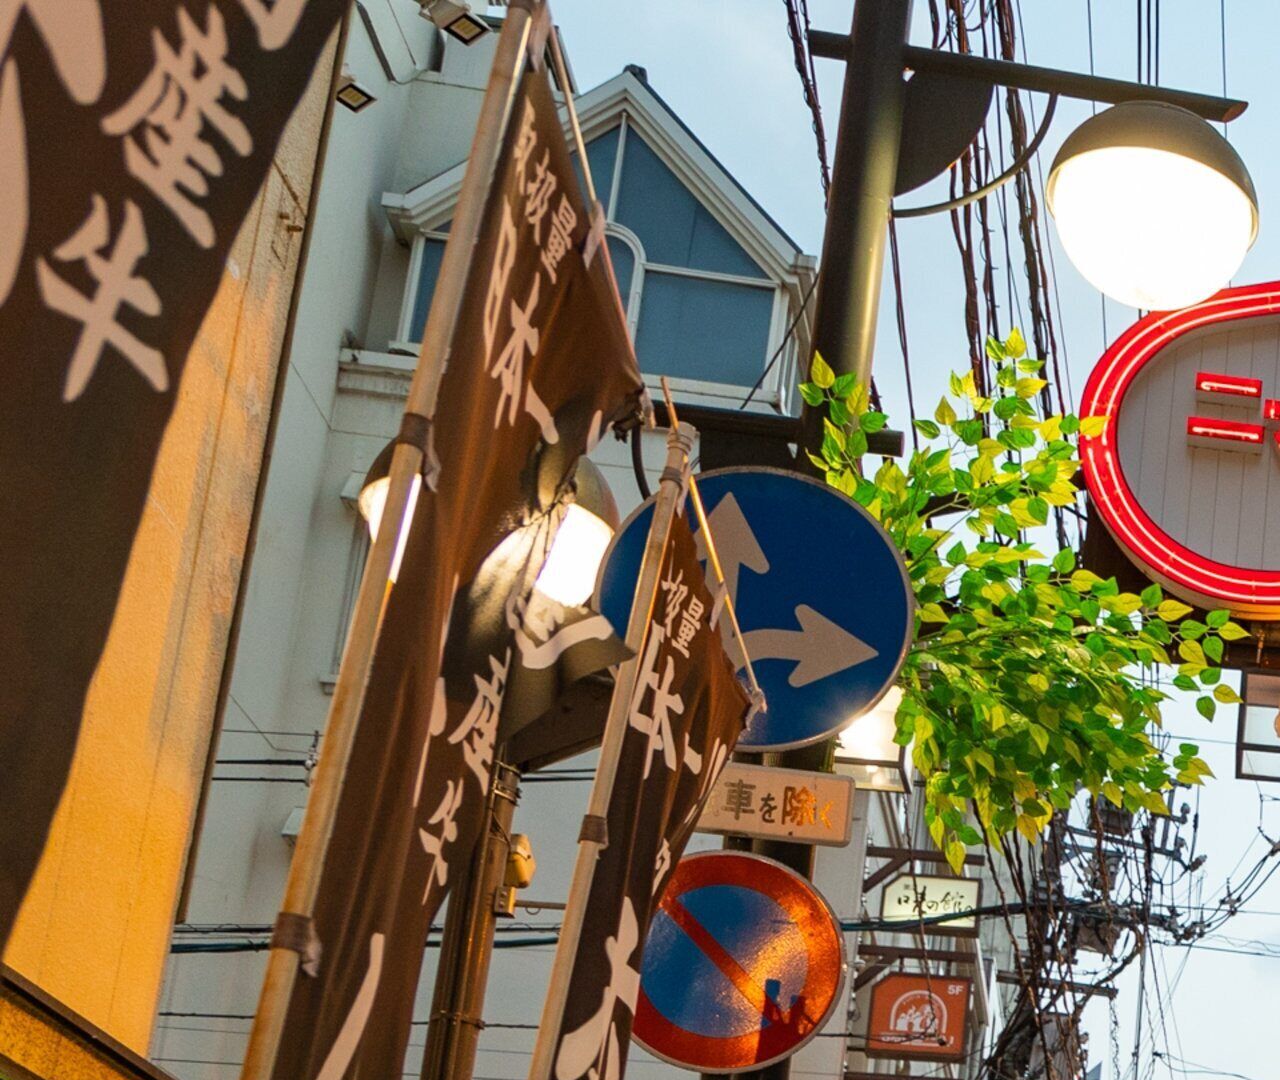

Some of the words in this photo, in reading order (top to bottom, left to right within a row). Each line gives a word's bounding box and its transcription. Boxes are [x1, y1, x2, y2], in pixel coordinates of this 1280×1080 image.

[660, 540, 704, 659] 扱量
[704, 778, 833, 830] 車を除く
[946, 984, 963, 995] 5F
